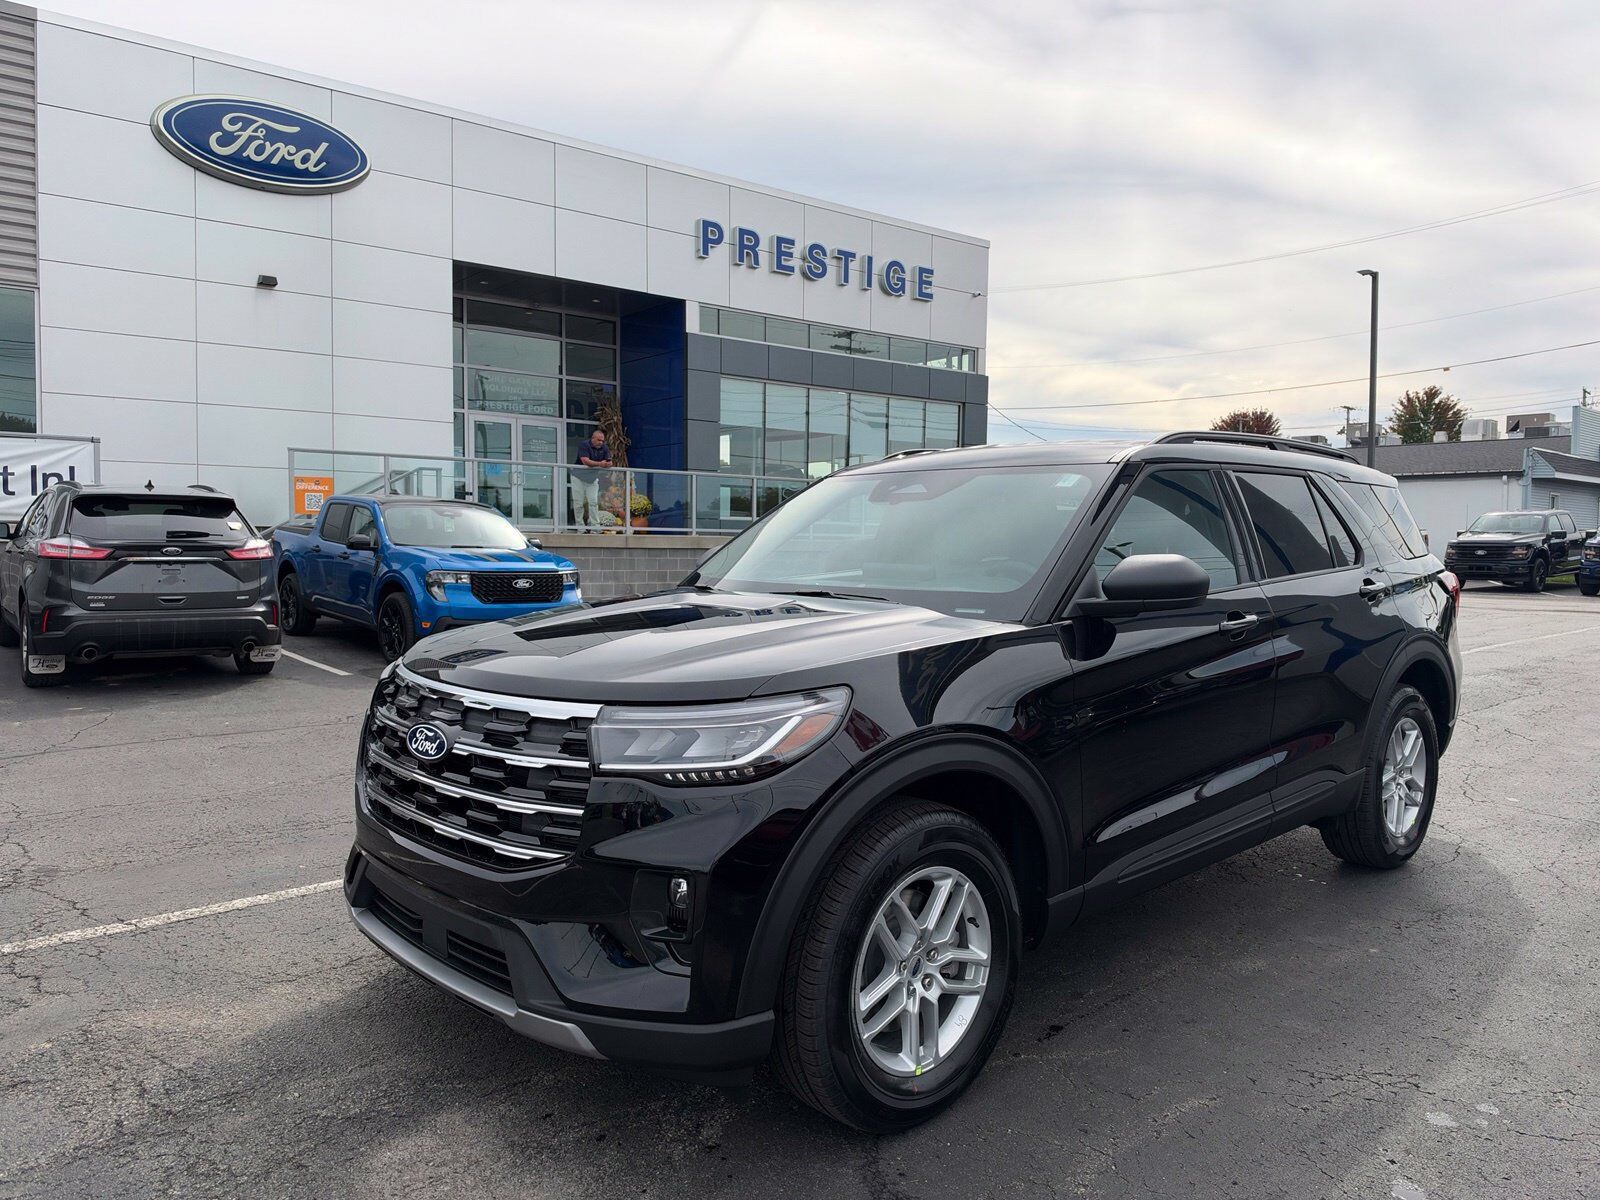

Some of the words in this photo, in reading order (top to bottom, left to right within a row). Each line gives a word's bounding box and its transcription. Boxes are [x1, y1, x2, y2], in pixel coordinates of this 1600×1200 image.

[209, 112, 330, 173] Ford
[696, 217, 935, 302] PRESTIGE
[476, 400, 525, 412] PRESTIGE
[528, 403, 554, 414] FORD
[411, 727, 440, 755] Ford
